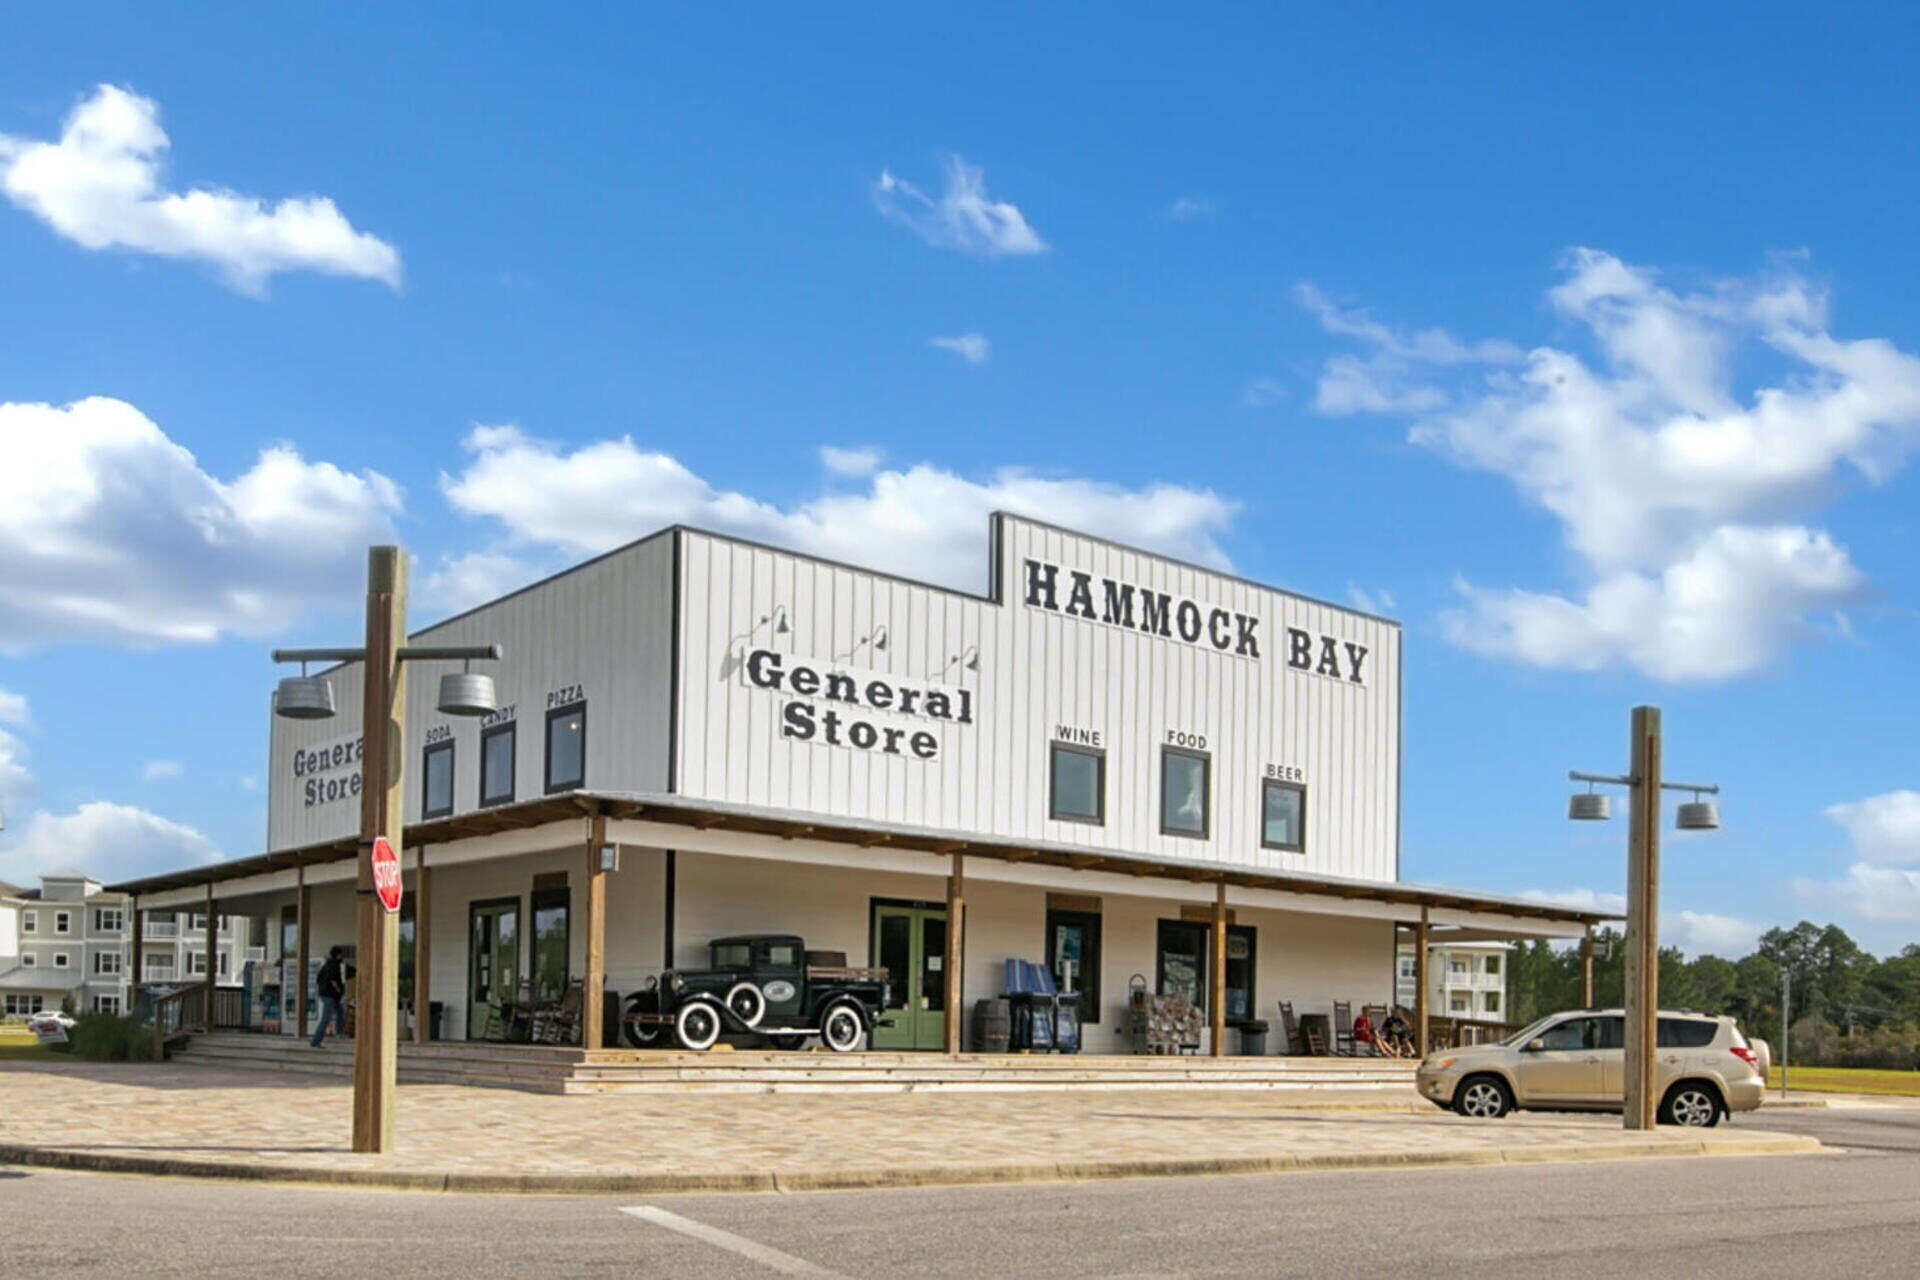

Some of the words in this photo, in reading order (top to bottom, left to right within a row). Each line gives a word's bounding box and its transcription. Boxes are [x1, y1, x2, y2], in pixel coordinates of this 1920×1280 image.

[1025, 560, 1260, 658] HAMMOCK
[1288, 627, 1368, 683] BAY
[547, 684, 584, 708] PIZZA
[747, 650, 972, 724] General
[425, 725, 451, 743] SODA
[784, 701, 939, 758] Store
[1057, 725, 1101, 746] WINE
[1167, 730, 1207, 749] FOOD
[294, 737, 364, 777] Genera
[1267, 763, 1303, 781] BEER
[305, 772, 362, 807] Store
[374, 861, 400, 888] STOP
